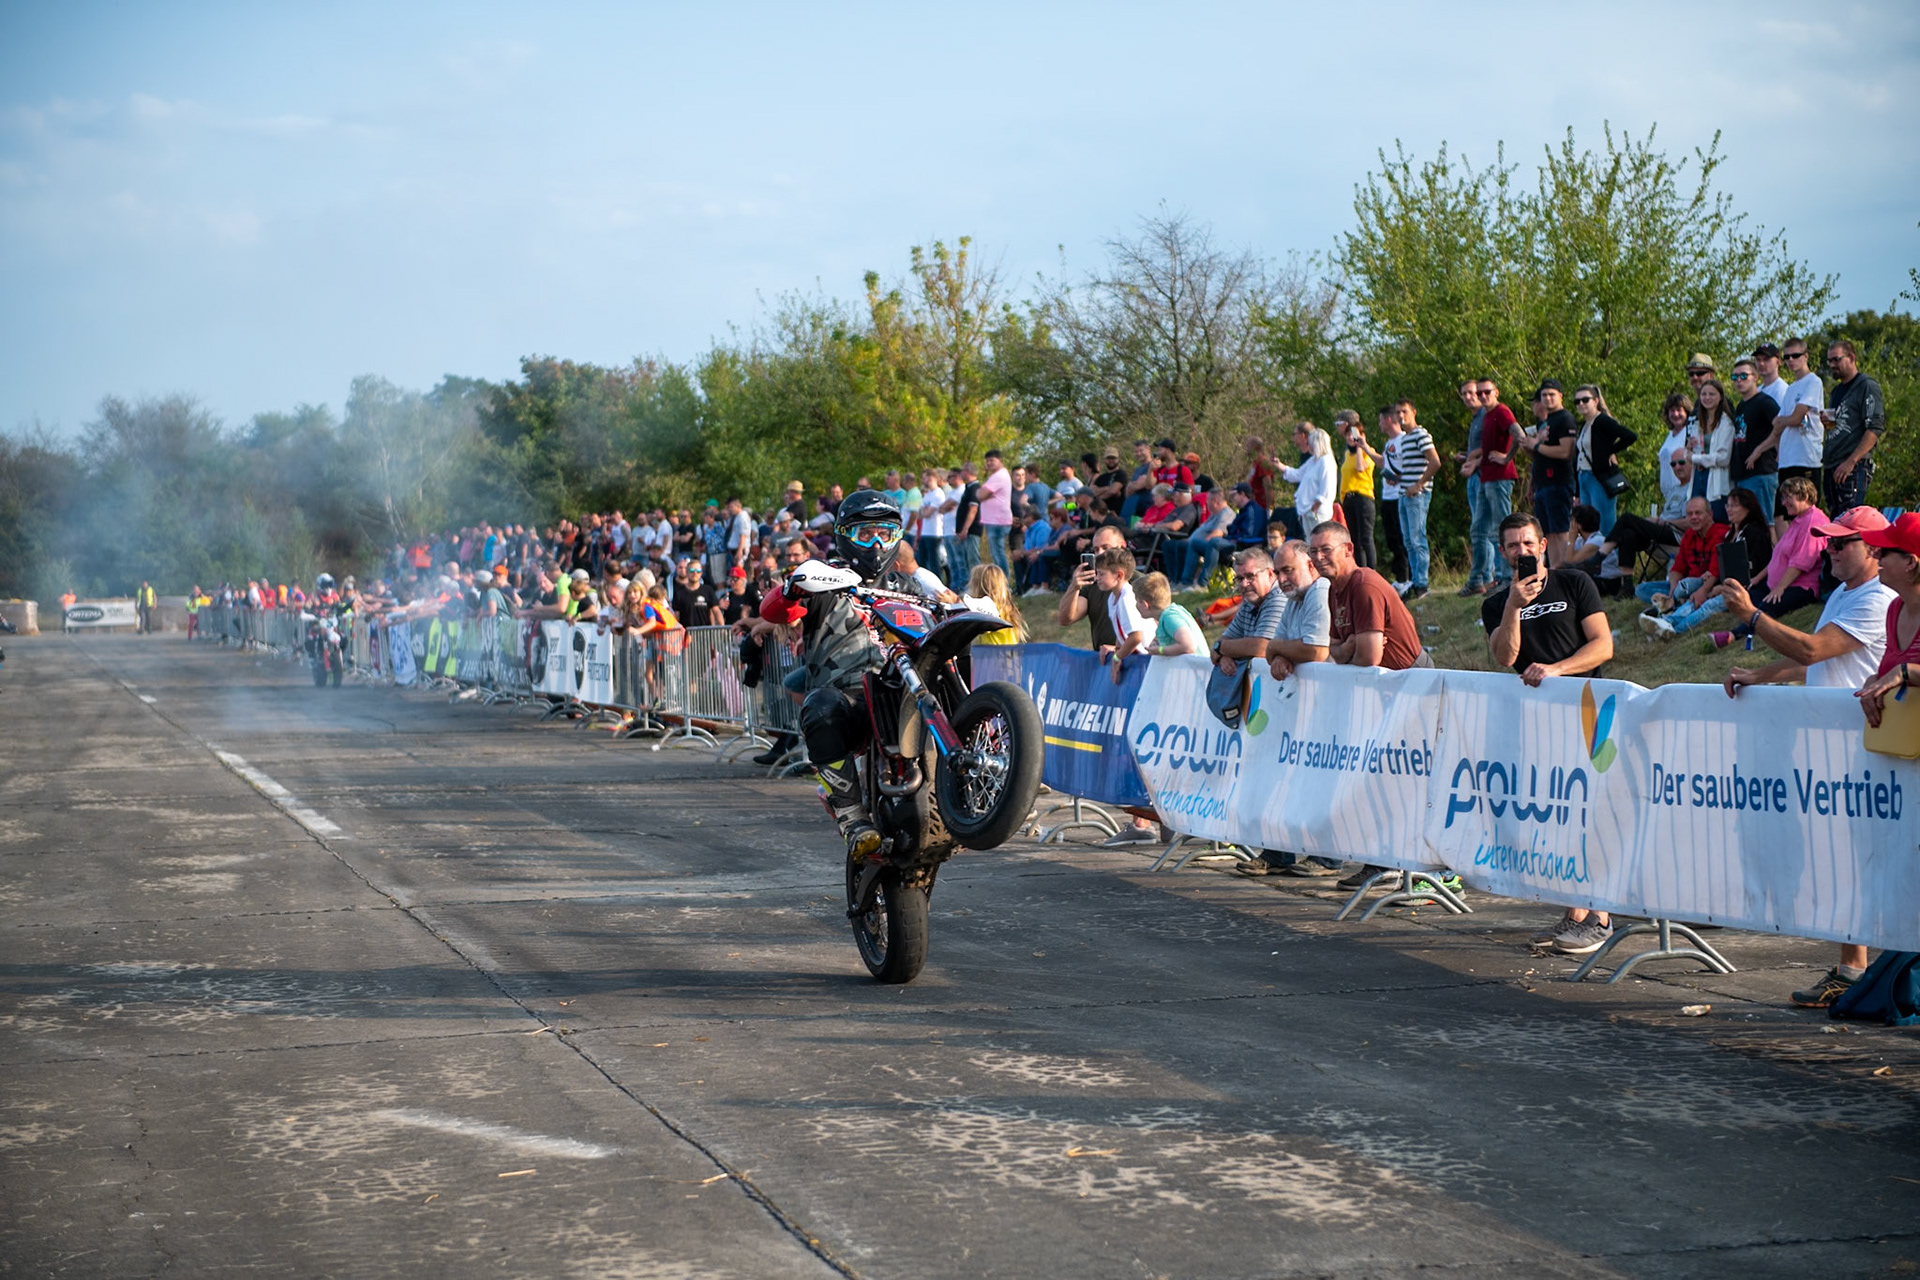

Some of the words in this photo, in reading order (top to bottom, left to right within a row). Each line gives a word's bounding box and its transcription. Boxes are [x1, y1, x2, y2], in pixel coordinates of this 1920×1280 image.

[892, 610, 924, 627] 12
[1045, 698, 1128, 736] MICHELIN
[1278, 731, 1304, 766] Der
[1304, 734, 1361, 772] saubere
[1361, 738, 1433, 777] Vertrieb
[1652, 763, 1685, 806] Der
[1691, 763, 1787, 813] saubere
[1793, 769, 1903, 821] Vertrieb
[1474, 823, 1590, 883] international
